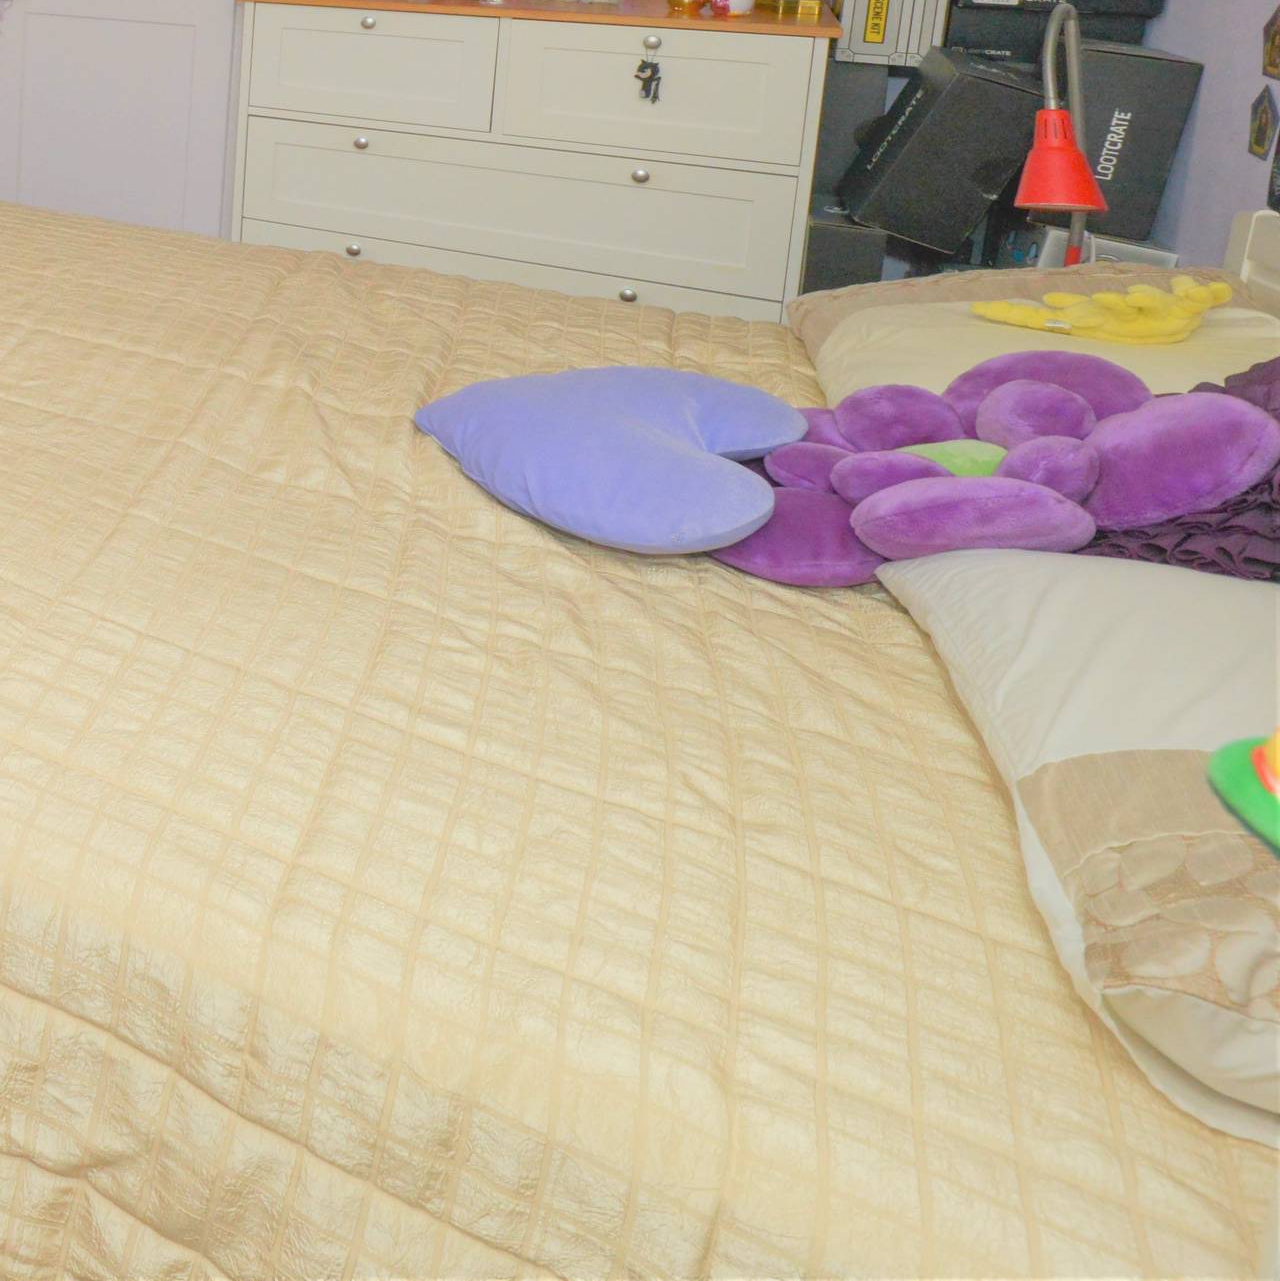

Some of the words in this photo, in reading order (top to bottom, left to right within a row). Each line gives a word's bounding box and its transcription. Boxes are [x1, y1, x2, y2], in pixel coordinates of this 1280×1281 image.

[870, 23, 881, 35] KIT
[867, 89, 923, 170] LOOTCRATE
[1095, 110, 1132, 180] LOOTCRATE
